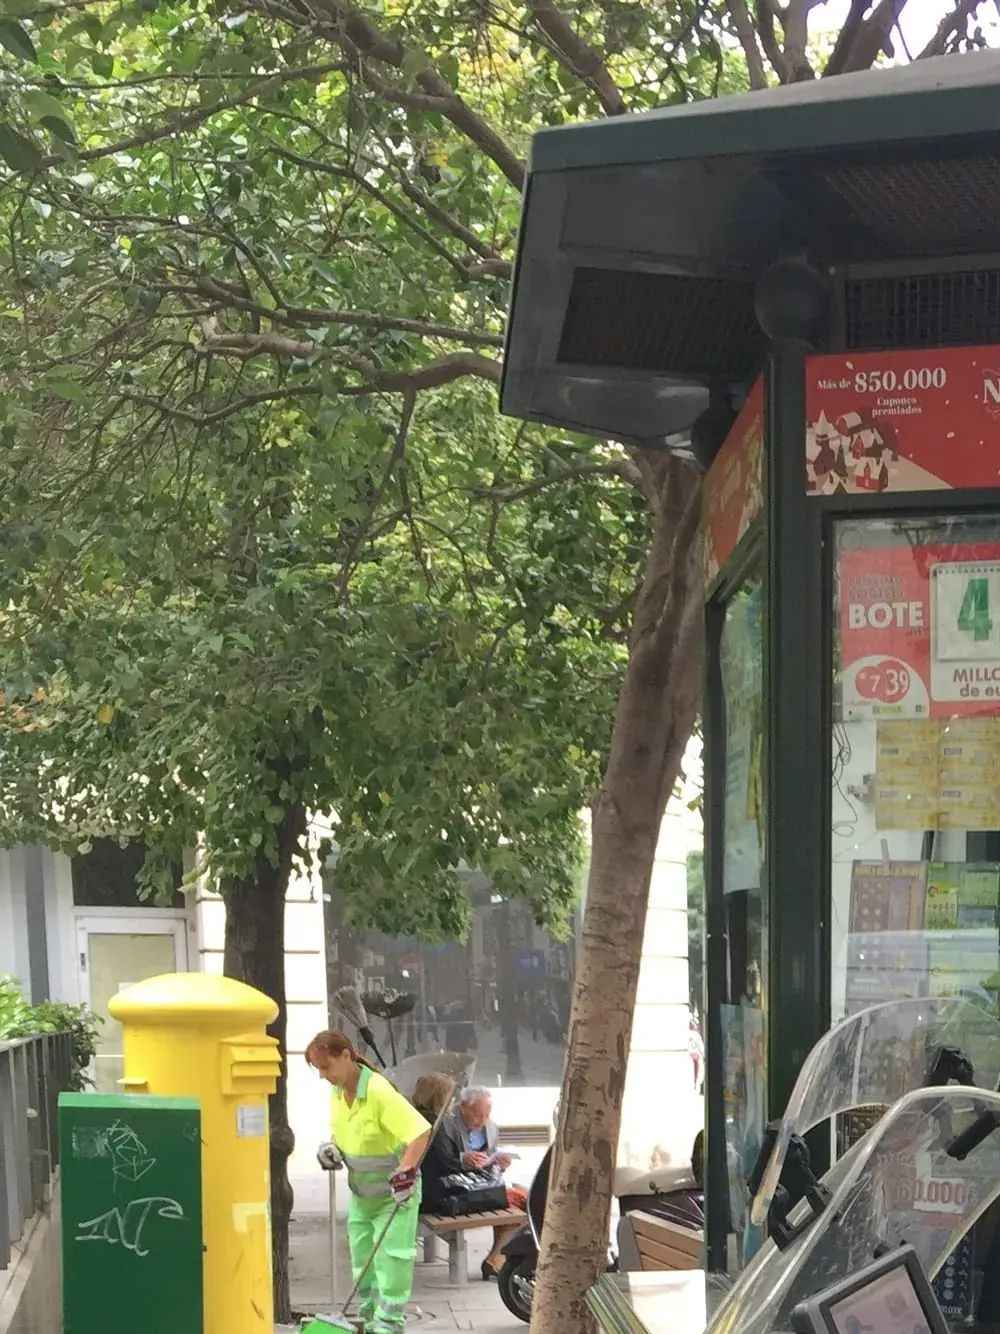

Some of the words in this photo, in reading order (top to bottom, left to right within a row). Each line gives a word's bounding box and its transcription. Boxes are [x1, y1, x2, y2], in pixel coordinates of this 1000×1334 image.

[839, 378, 851, 389] de
[854, 367, 947, 393] 850.000
[876, 396, 917, 408] Cupones
[872, 405, 922, 418] premiados
[849, 601, 923, 628] BOTE
[960, 684, 979, 698] de
